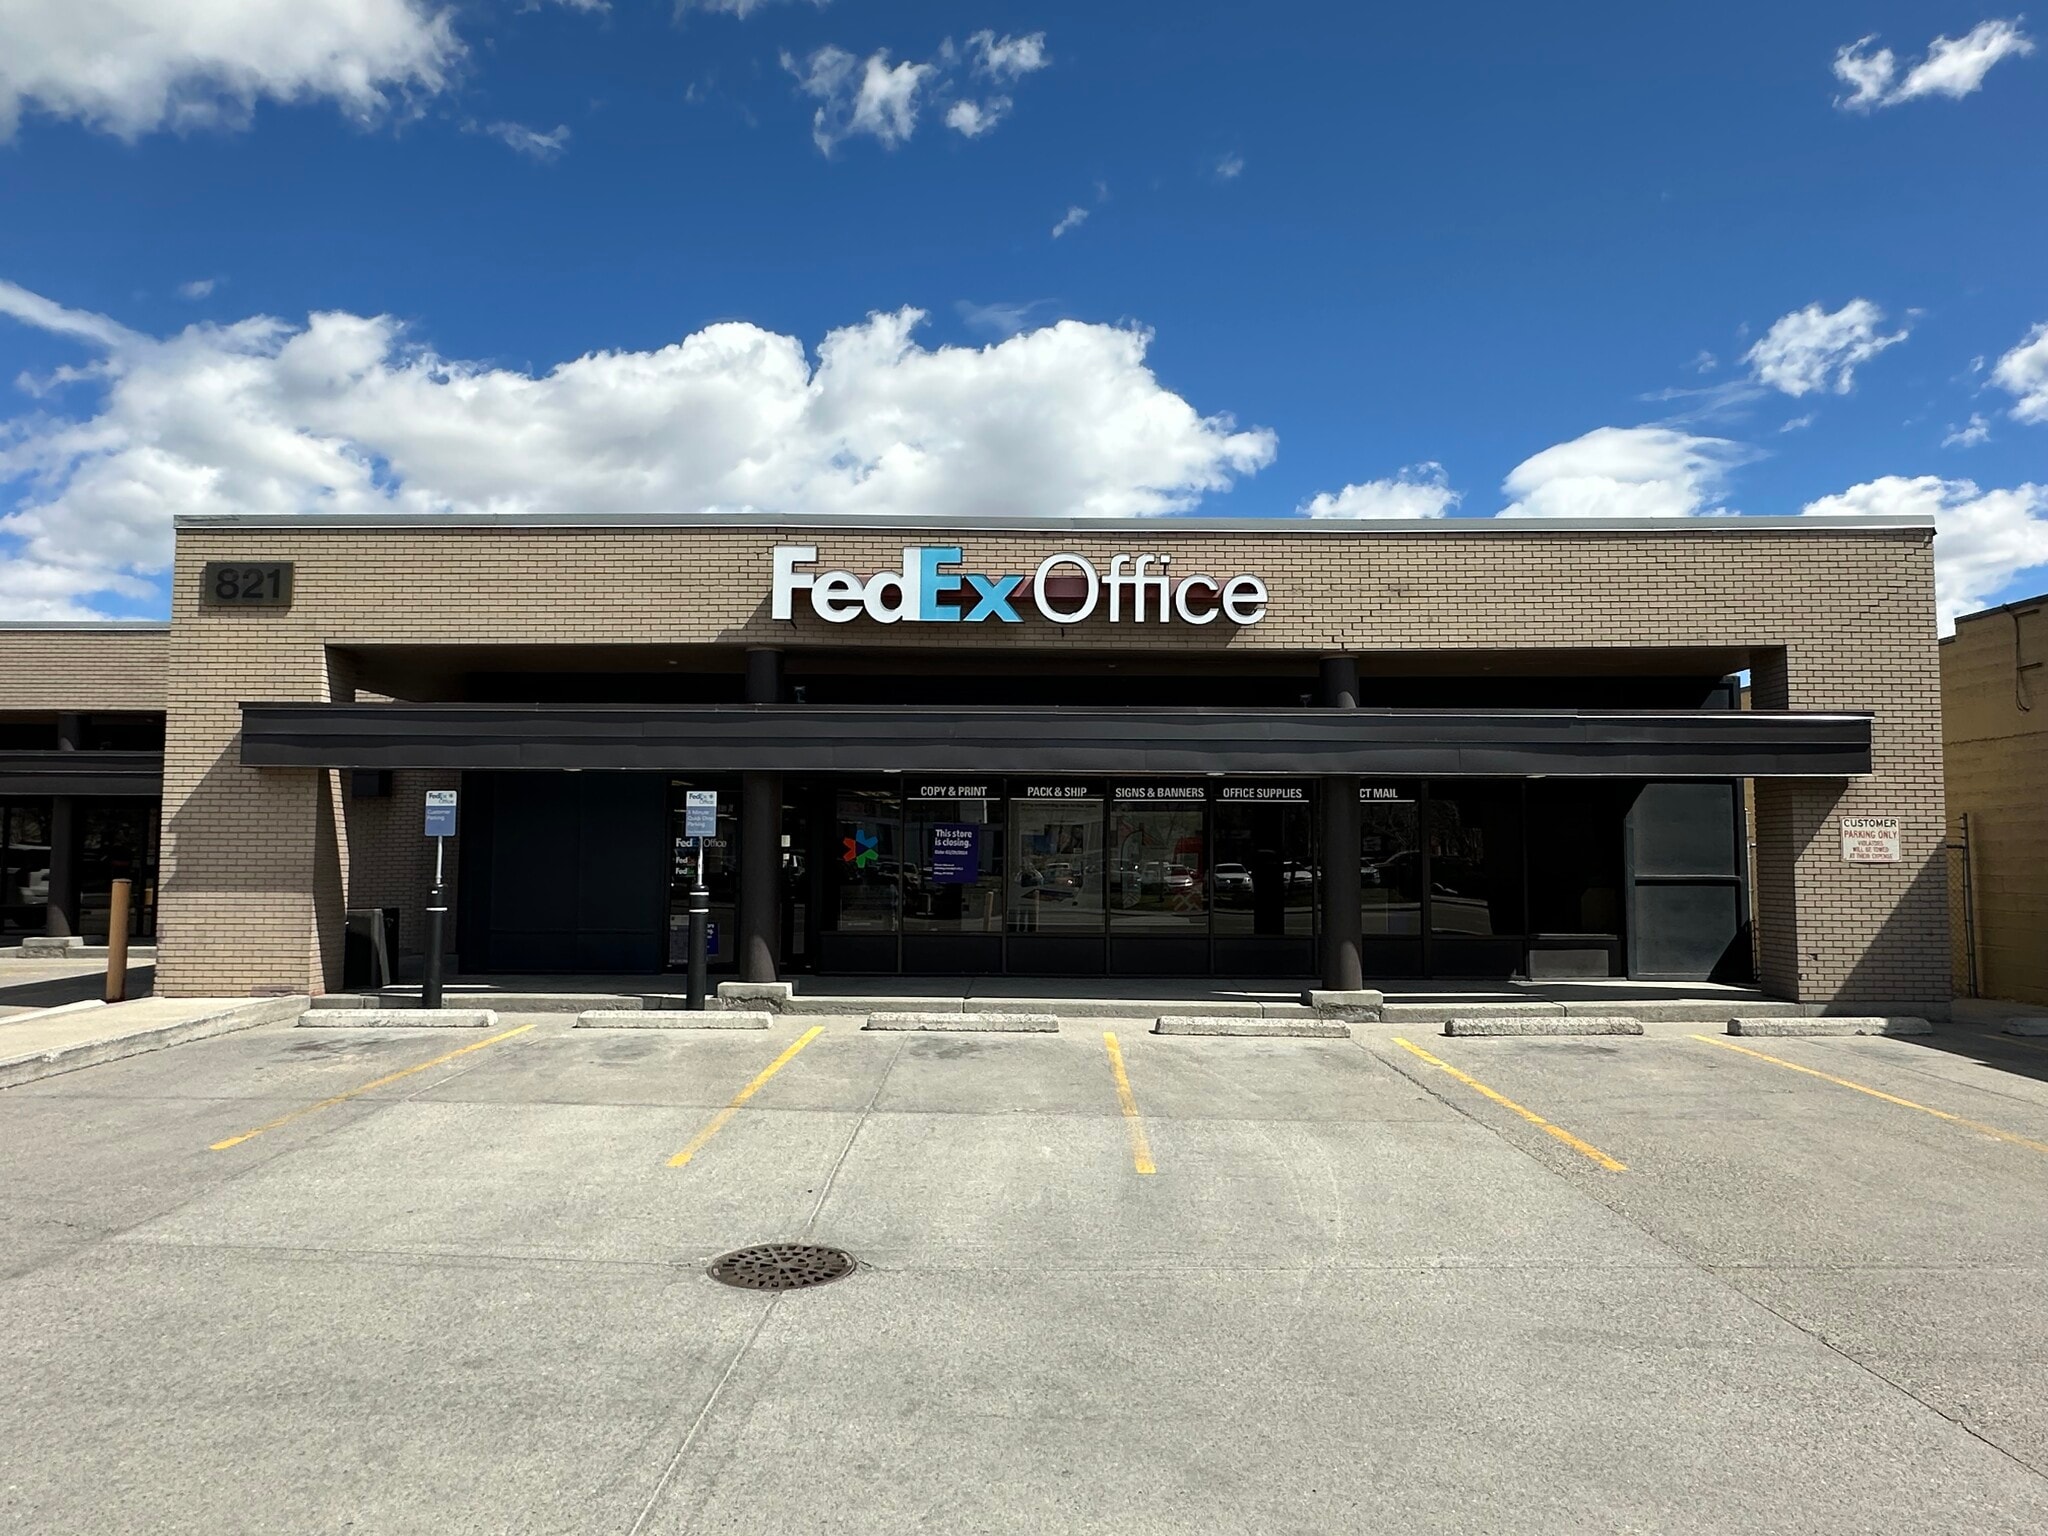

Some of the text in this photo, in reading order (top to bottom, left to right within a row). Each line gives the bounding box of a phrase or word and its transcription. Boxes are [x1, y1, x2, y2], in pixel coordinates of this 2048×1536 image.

[215, 568, 280, 599] 821
[771, 545, 1269, 625] FedEx Office
[920, 786, 987, 797] COPY & PRINT
[1027, 786, 1087, 798] PACK & SHIP
[1115, 787, 1204, 798] SIGNS & BANNERS
[1223, 788, 1302, 799] OFFICE SUPPLIES
[1373, 788, 1398, 799] MAIL
[1844, 819, 1897, 828] CUSTOMER
[935, 829, 973, 838] This store
[1844, 830, 1897, 839] PARKING ONLY
[703, 838, 727, 848] Office
[934, 837, 972, 849] is closing.
